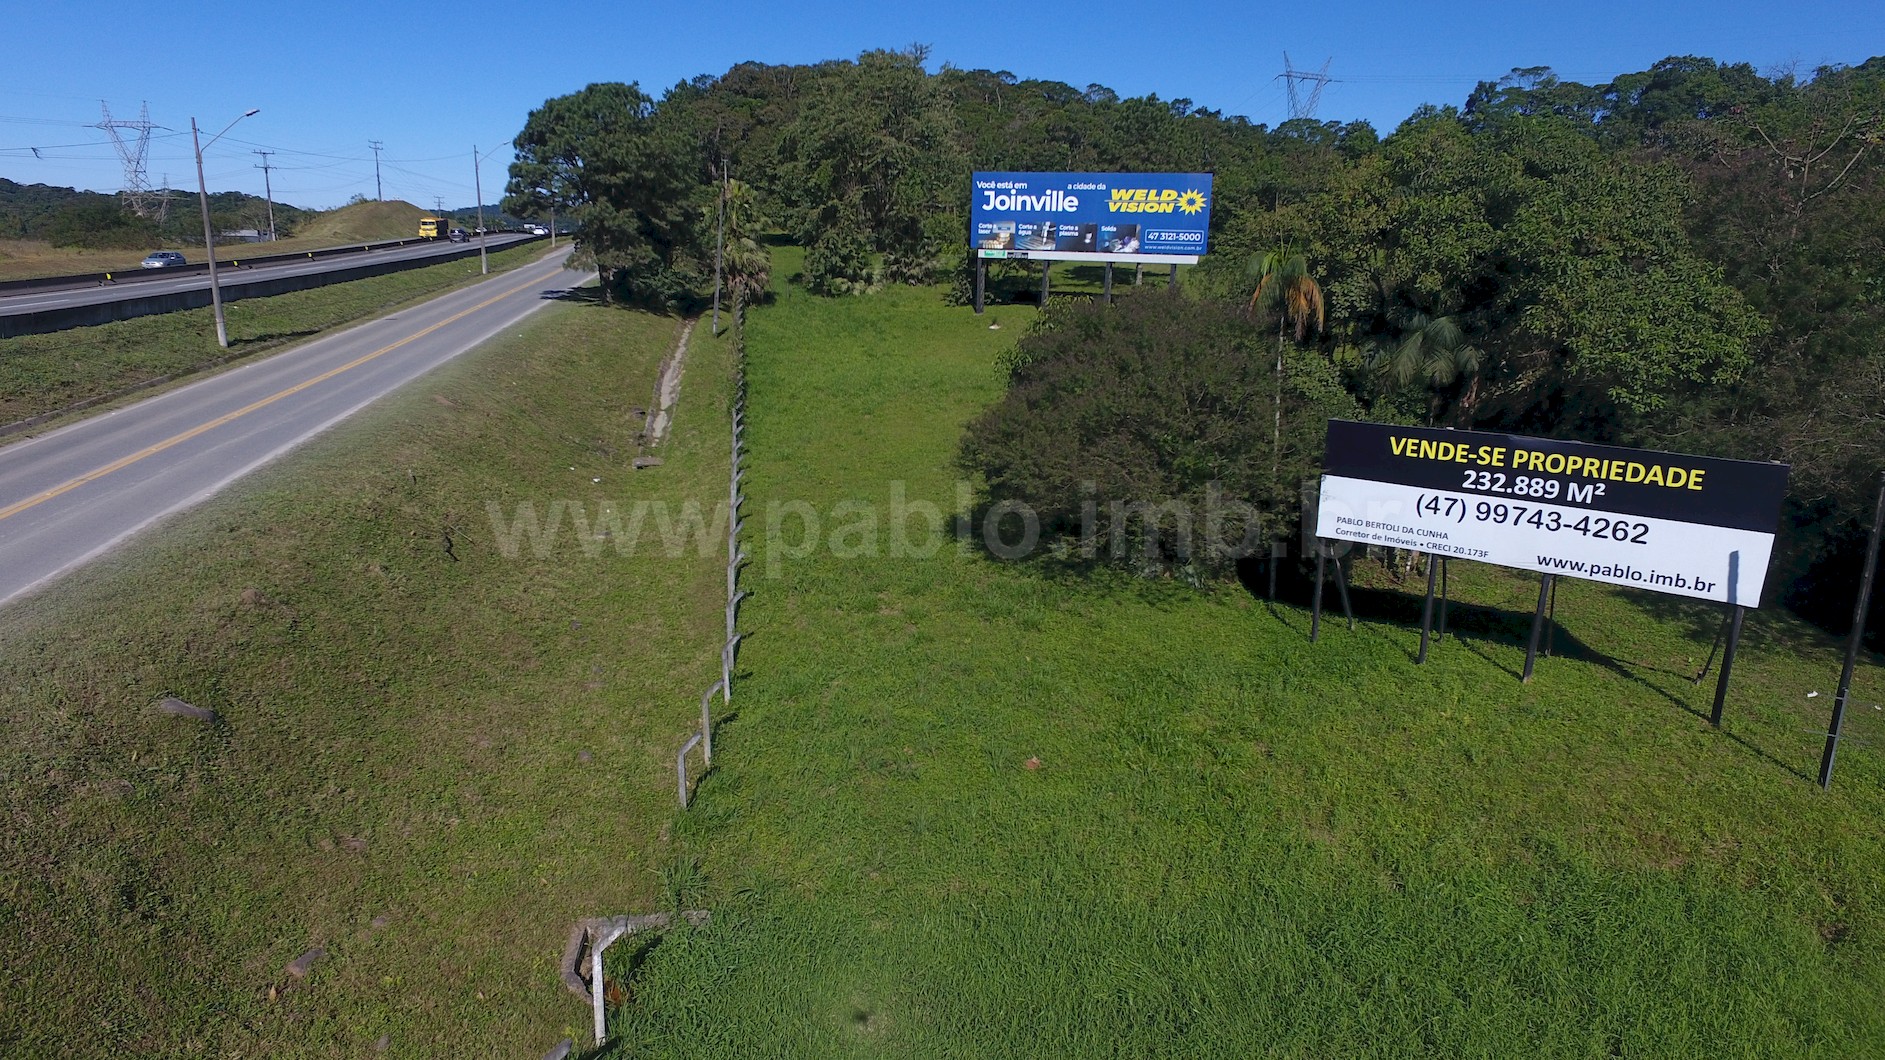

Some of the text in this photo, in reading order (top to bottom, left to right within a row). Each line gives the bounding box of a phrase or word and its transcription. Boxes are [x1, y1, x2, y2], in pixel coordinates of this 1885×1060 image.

[977, 181, 995, 189] Você
[997, 181, 1013, 189] está
[1111, 188, 1178, 200] WELD
[982, 189, 1078, 212] Joinville
[1108, 202, 1175, 213] VISION
[1148, 232, 1201, 241] 47 3121-5000
[1389, 436, 1706, 491] VENDE-SE PROPRIEDADE
[1461, 469, 1606, 504] 232.889 M²
[1336, 516, 1449, 540] PABLO BERTOLI DA CUNHA
[1416, 493, 1650, 545] (47) 99743-4262
[1335, 527, 1489, 558] Corretor de Imóveis CRECI 20.173F
[1536, 555, 1716, 593] www.pablo.imb.br
